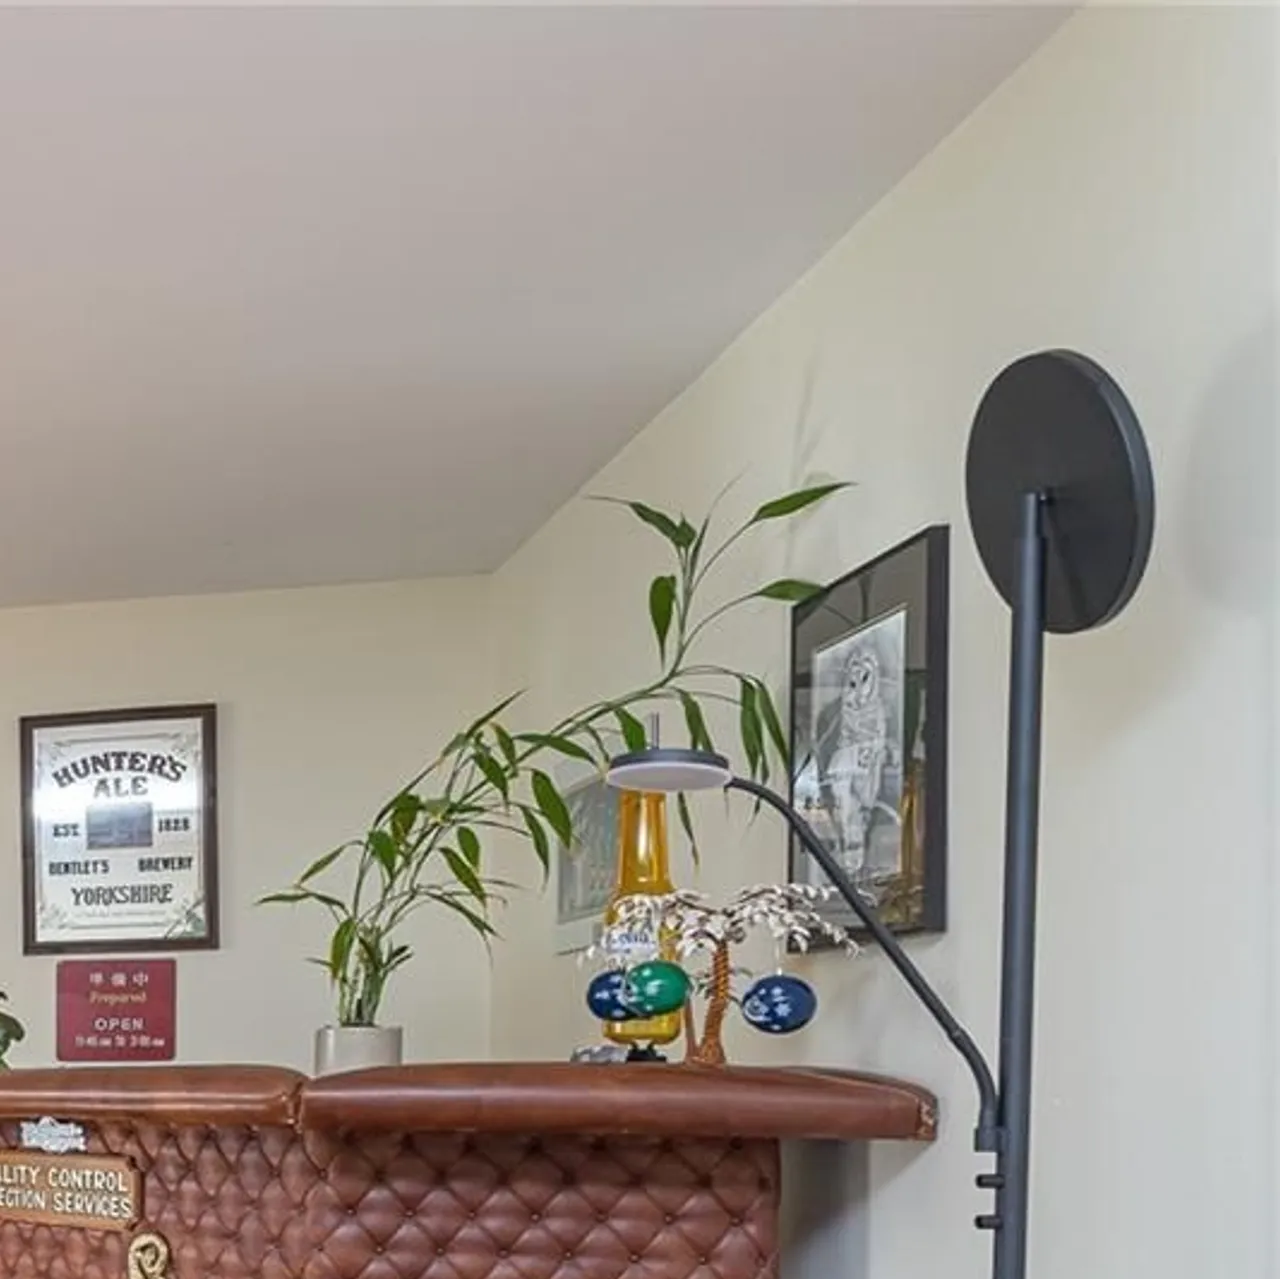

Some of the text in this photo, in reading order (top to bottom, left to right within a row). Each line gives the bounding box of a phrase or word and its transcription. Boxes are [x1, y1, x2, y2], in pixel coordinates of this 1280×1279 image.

[51, 751, 187, 789] HUNTER'S
[93, 776, 149, 798] ALE
[137, 856, 194, 873] BREWERY
[70, 883, 173, 907] YORKSHIRE
[94, 1018, 144, 1031] OPEN
[48, 1167, 129, 1193] CONTROL
[53, 1192, 135, 1220] SERVICES
